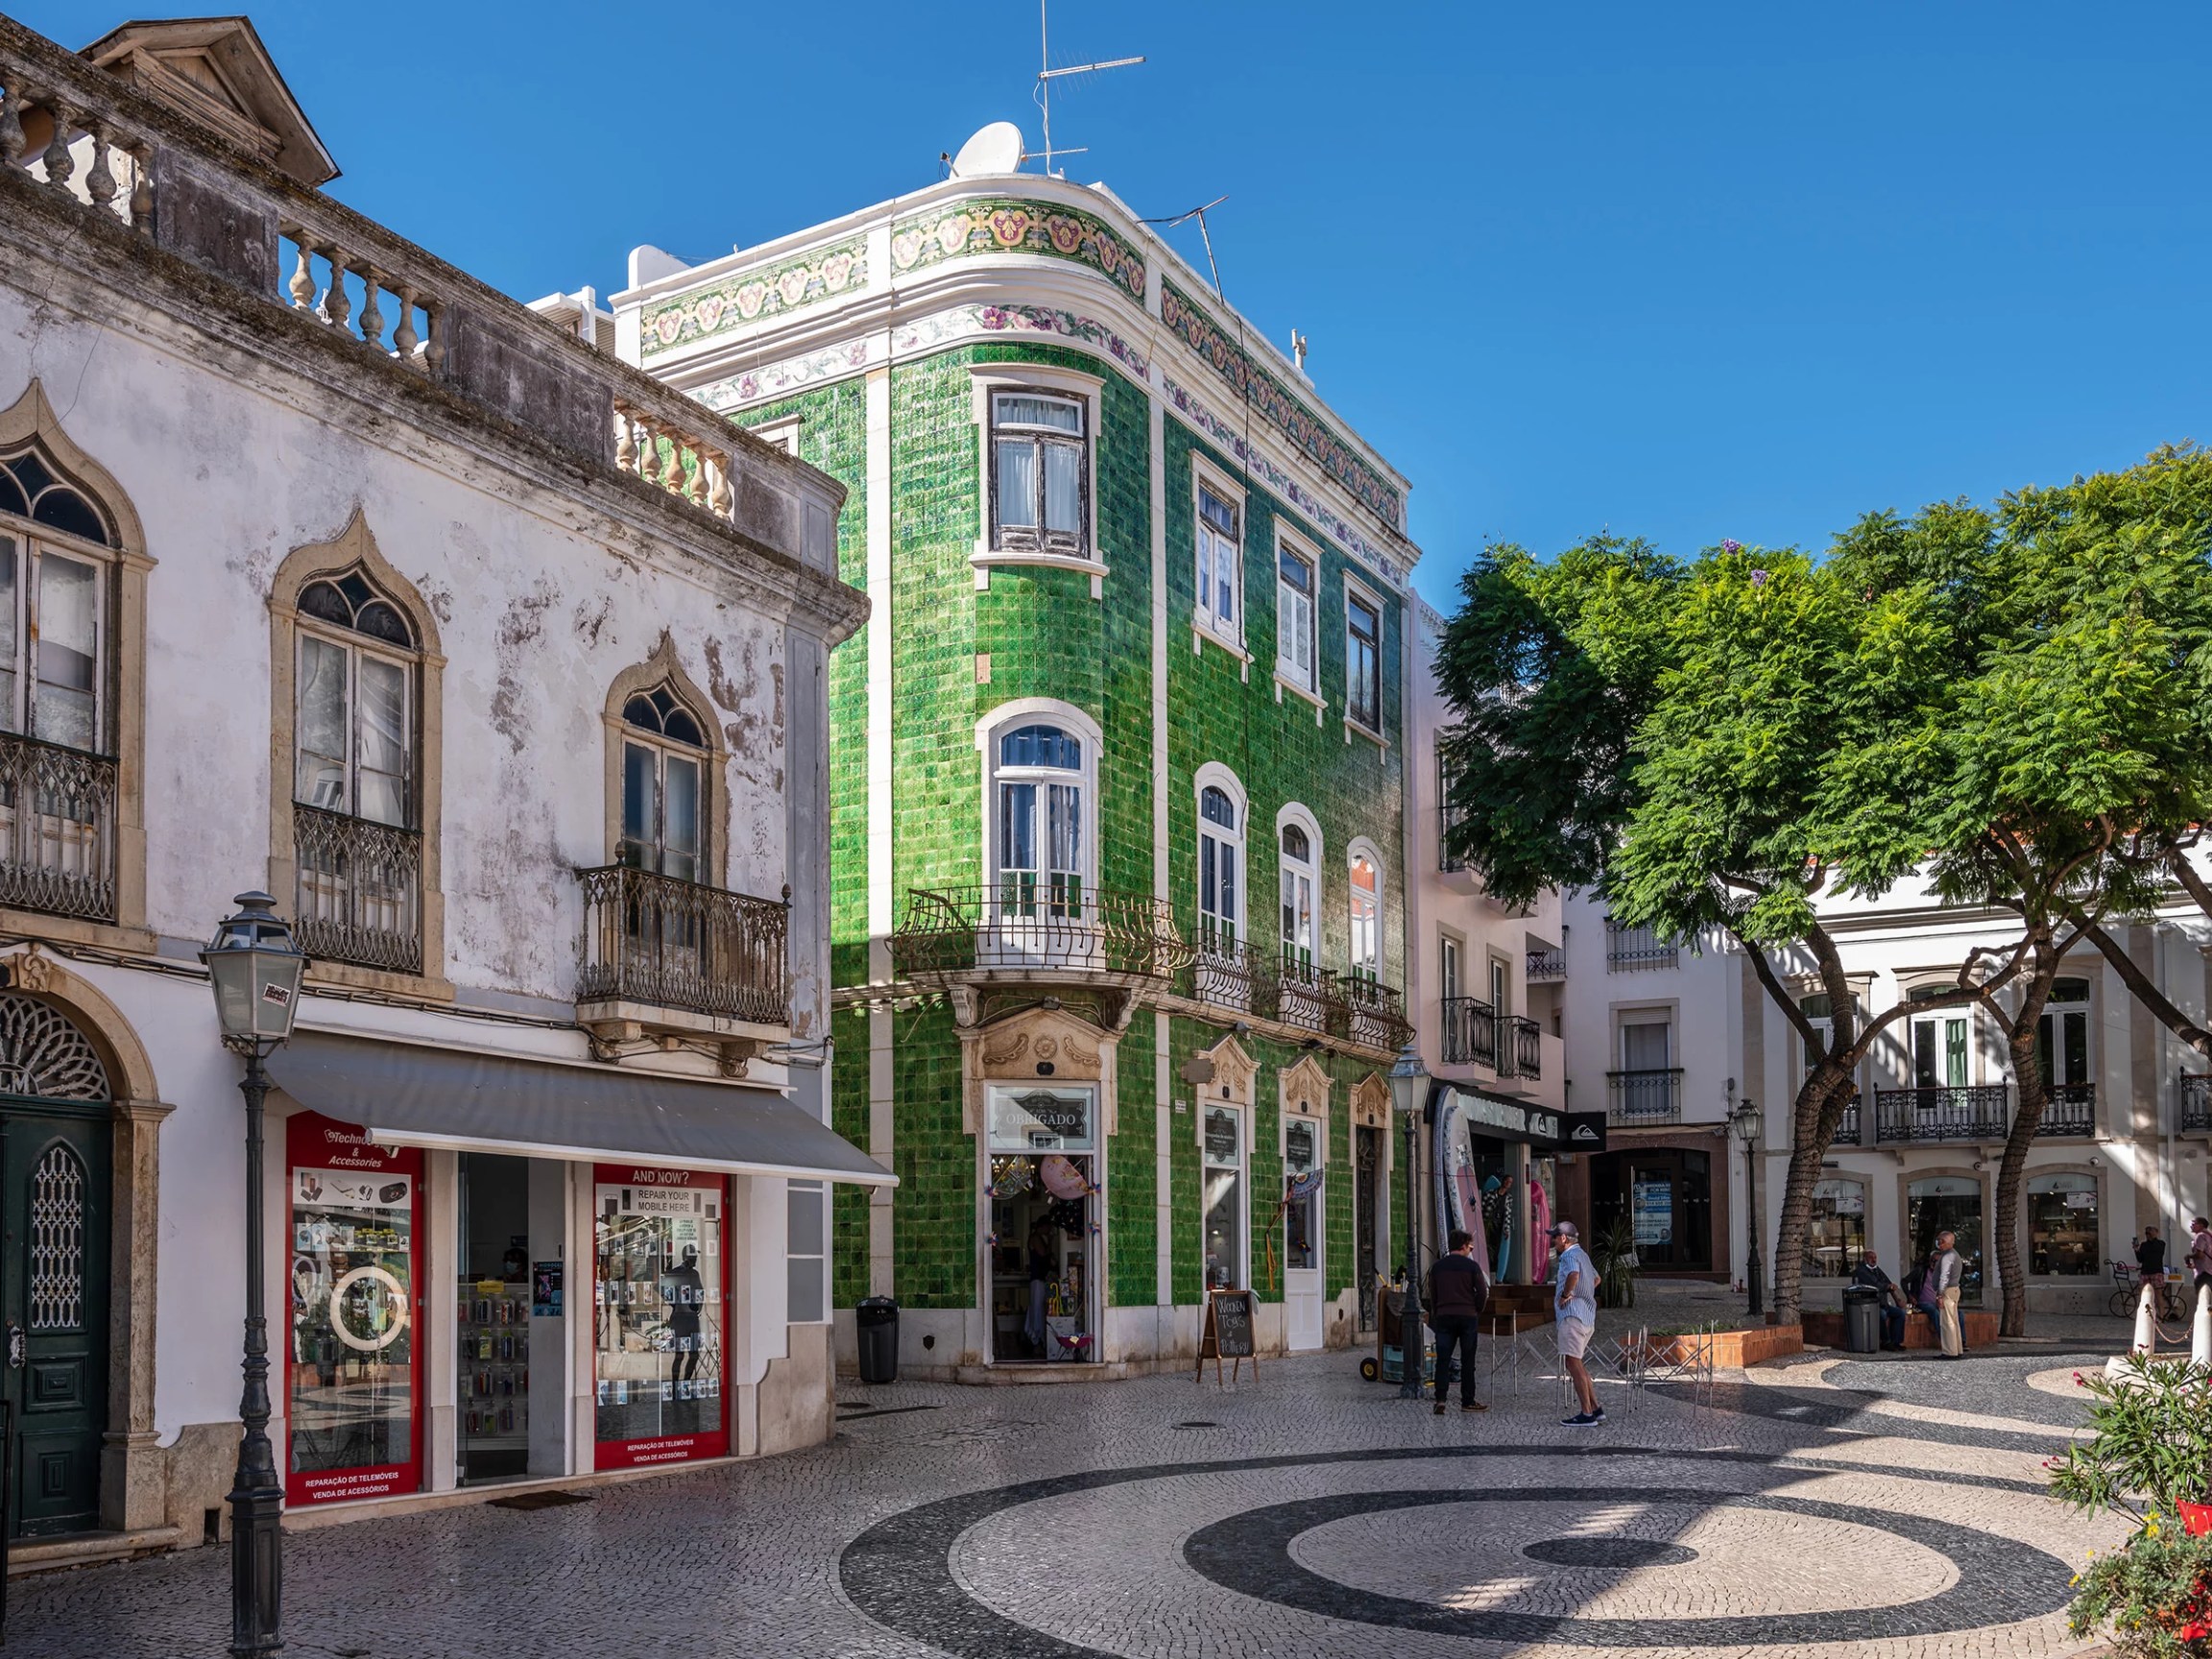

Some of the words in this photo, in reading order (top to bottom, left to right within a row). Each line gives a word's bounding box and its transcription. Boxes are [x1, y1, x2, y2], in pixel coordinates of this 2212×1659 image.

[1006, 1114, 1075, 1125] OBRIGADO
[351, 1147, 360, 1157] &
[328, 1155, 382, 1168] Accessories
[633, 1170, 655, 1183] AND
[658, 1171, 689, 1185] NOW?
[638, 1190, 666, 1199] REPAIR
[668, 1190, 689, 1200] YOUR
[638, 1201, 667, 1211] MOBILE
[669, 1203, 689, 1212] HERE
[305, 1477, 347, 1487] REPARAÇÃO
[359, 1472, 398, 1482] TELEMÓVEIS
[348, 1484, 389, 1496] ACESSÓRIOS
